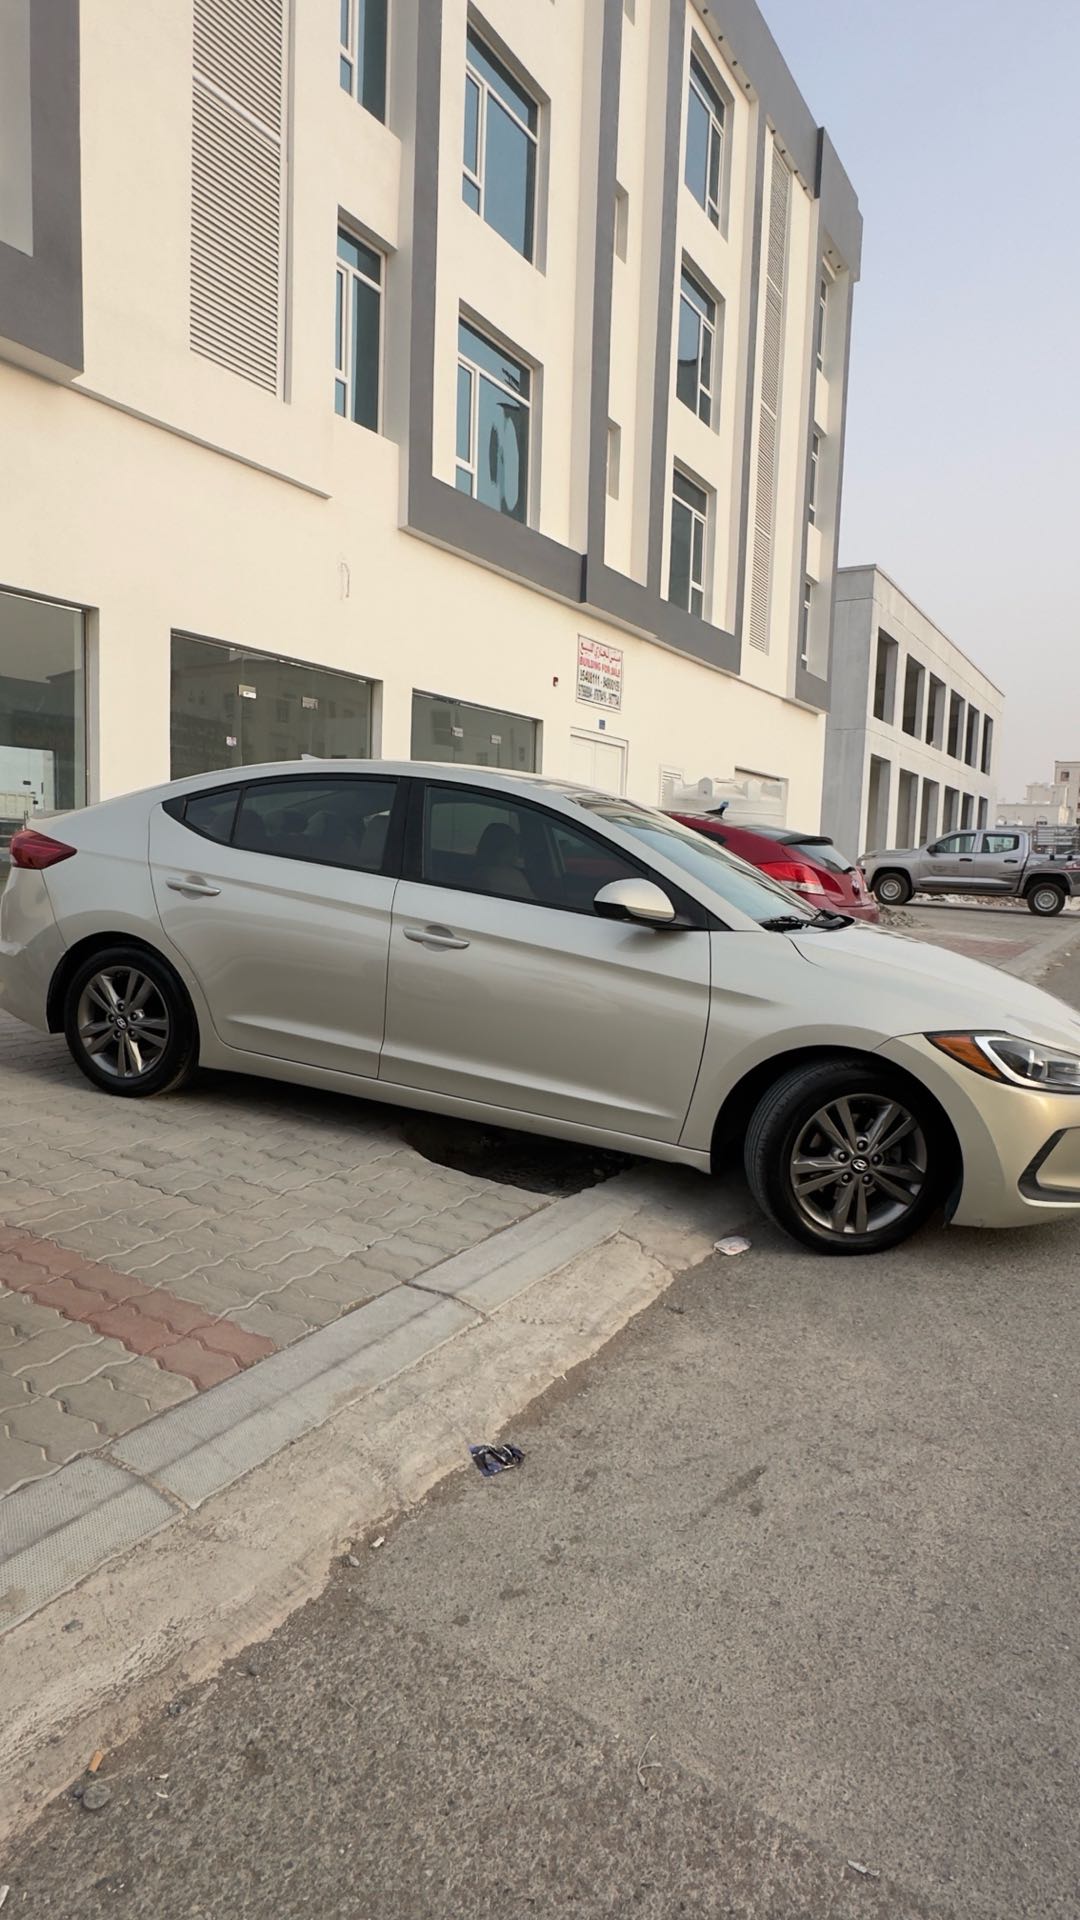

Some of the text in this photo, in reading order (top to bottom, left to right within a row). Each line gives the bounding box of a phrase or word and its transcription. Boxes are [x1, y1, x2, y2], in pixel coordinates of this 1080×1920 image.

[580, 656, 621, 678] BUILDING FOR SALE
